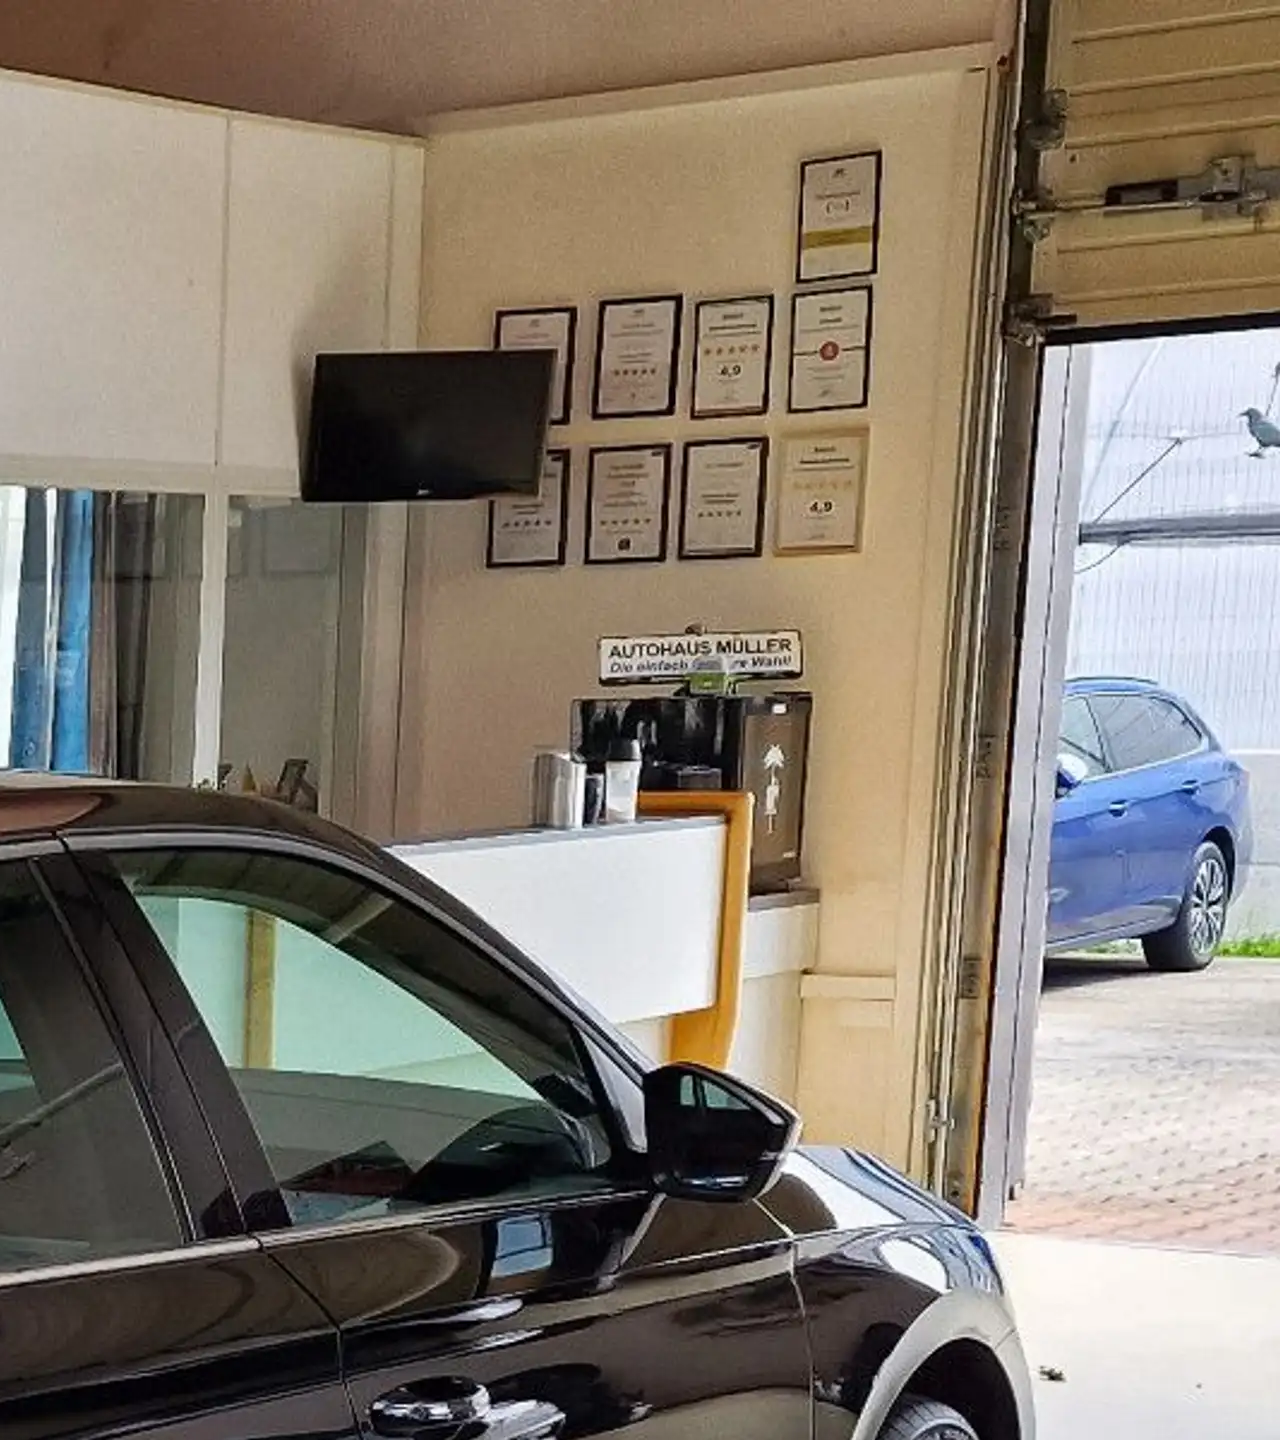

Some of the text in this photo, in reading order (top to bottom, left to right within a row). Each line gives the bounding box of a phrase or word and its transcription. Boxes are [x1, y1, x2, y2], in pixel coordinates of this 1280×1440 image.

[608, 637, 792, 659] AUTOHAUS MÜLLER
[609, 661, 633, 673] Die
[637, 657, 689, 673] einfach
